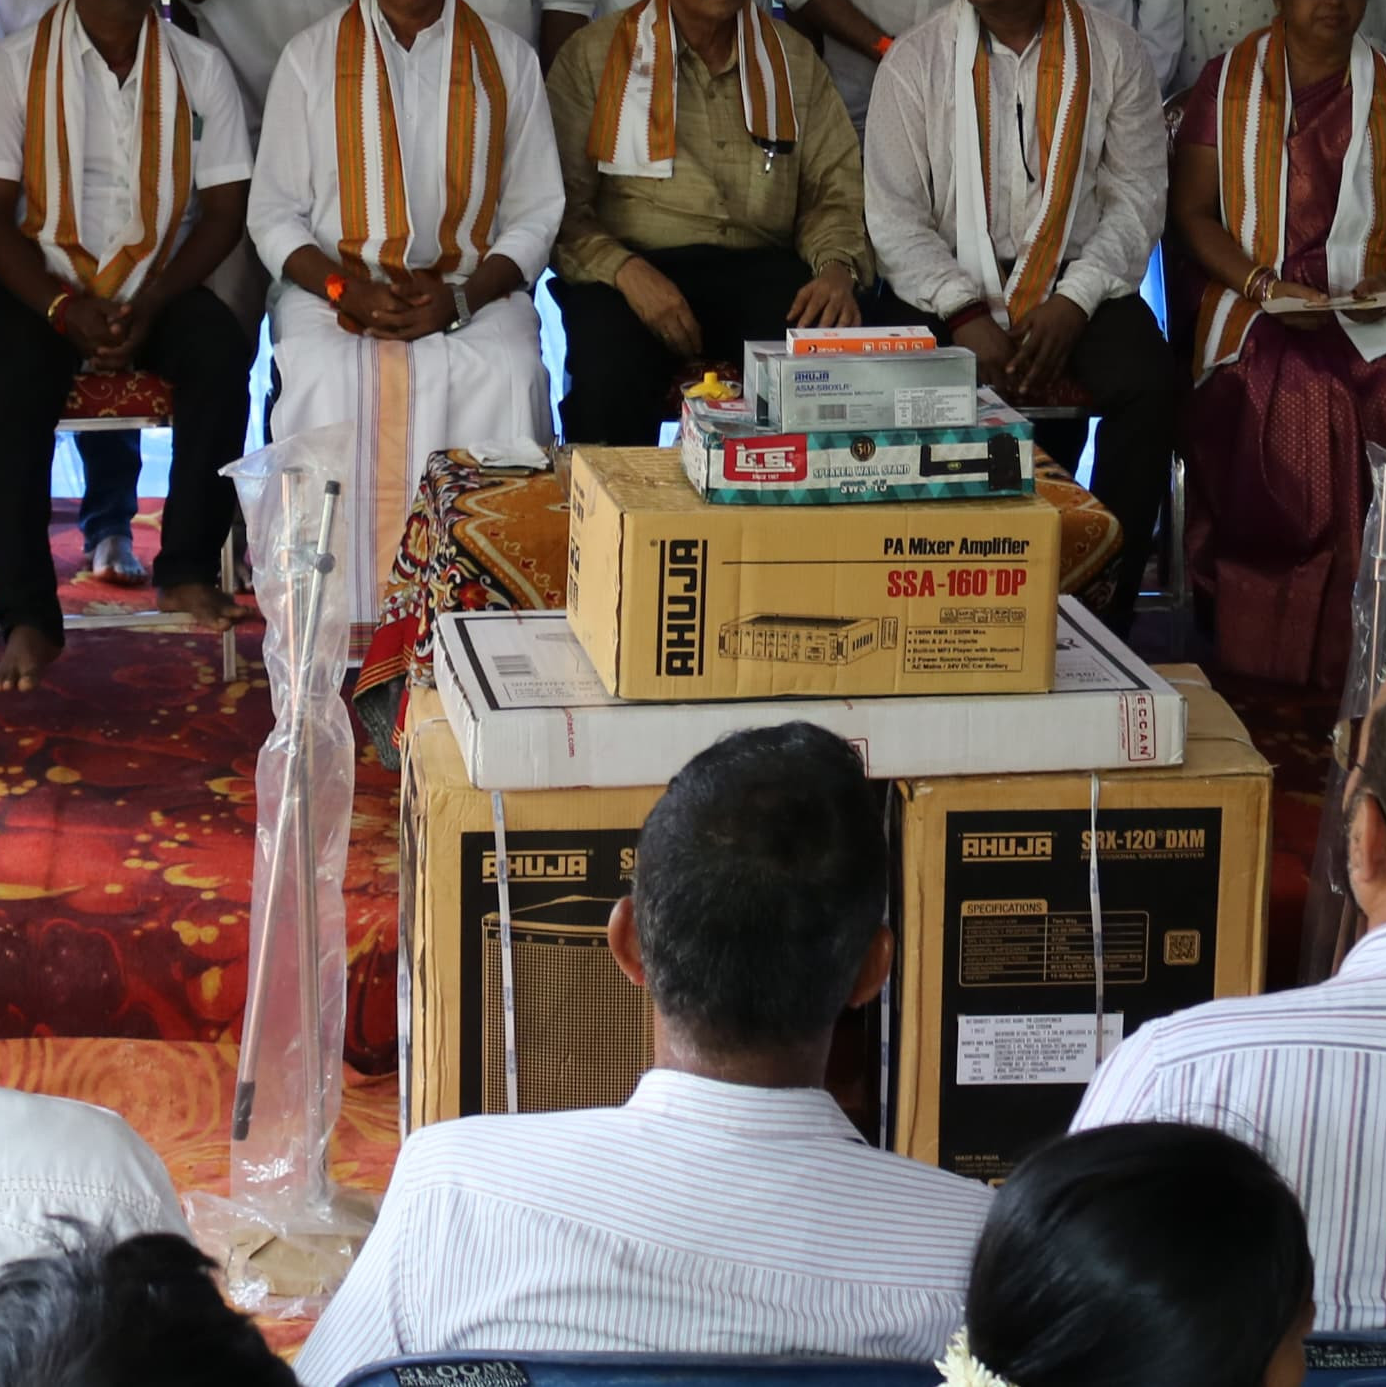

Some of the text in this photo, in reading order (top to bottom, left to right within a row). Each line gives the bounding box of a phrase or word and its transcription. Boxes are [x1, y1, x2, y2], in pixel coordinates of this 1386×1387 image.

[884, 537, 1029, 557] PA Mixer Amplifier
[665, 539, 699, 677] AHUJA
[1138, 695, 1148, 756] ECCAN
[962, 836, 1053, 857] AHUJA
[482, 856, 587, 878] AHUJA
[967, 902, 1043, 914] SPECIFICATIONS
